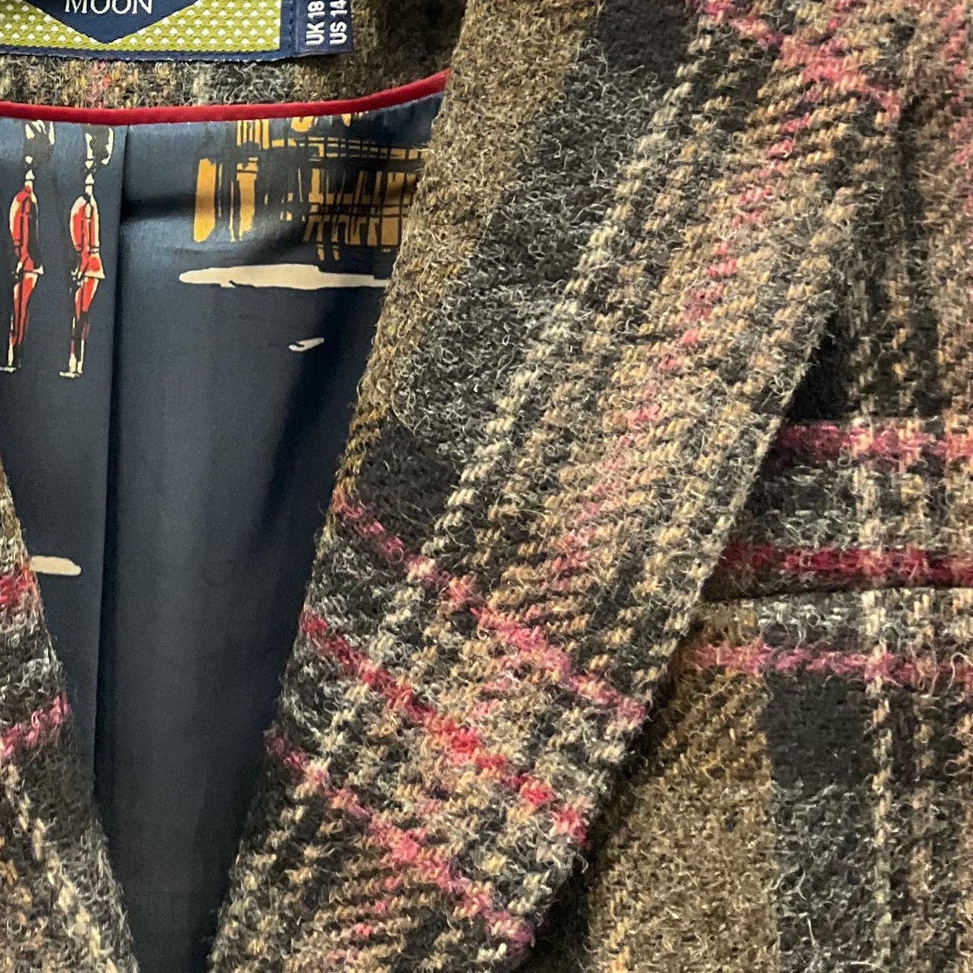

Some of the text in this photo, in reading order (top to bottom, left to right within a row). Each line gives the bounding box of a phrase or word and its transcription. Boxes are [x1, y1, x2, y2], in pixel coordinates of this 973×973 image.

[305, 0, 326, 46] UK 18
[329, 21, 347, 45] US
